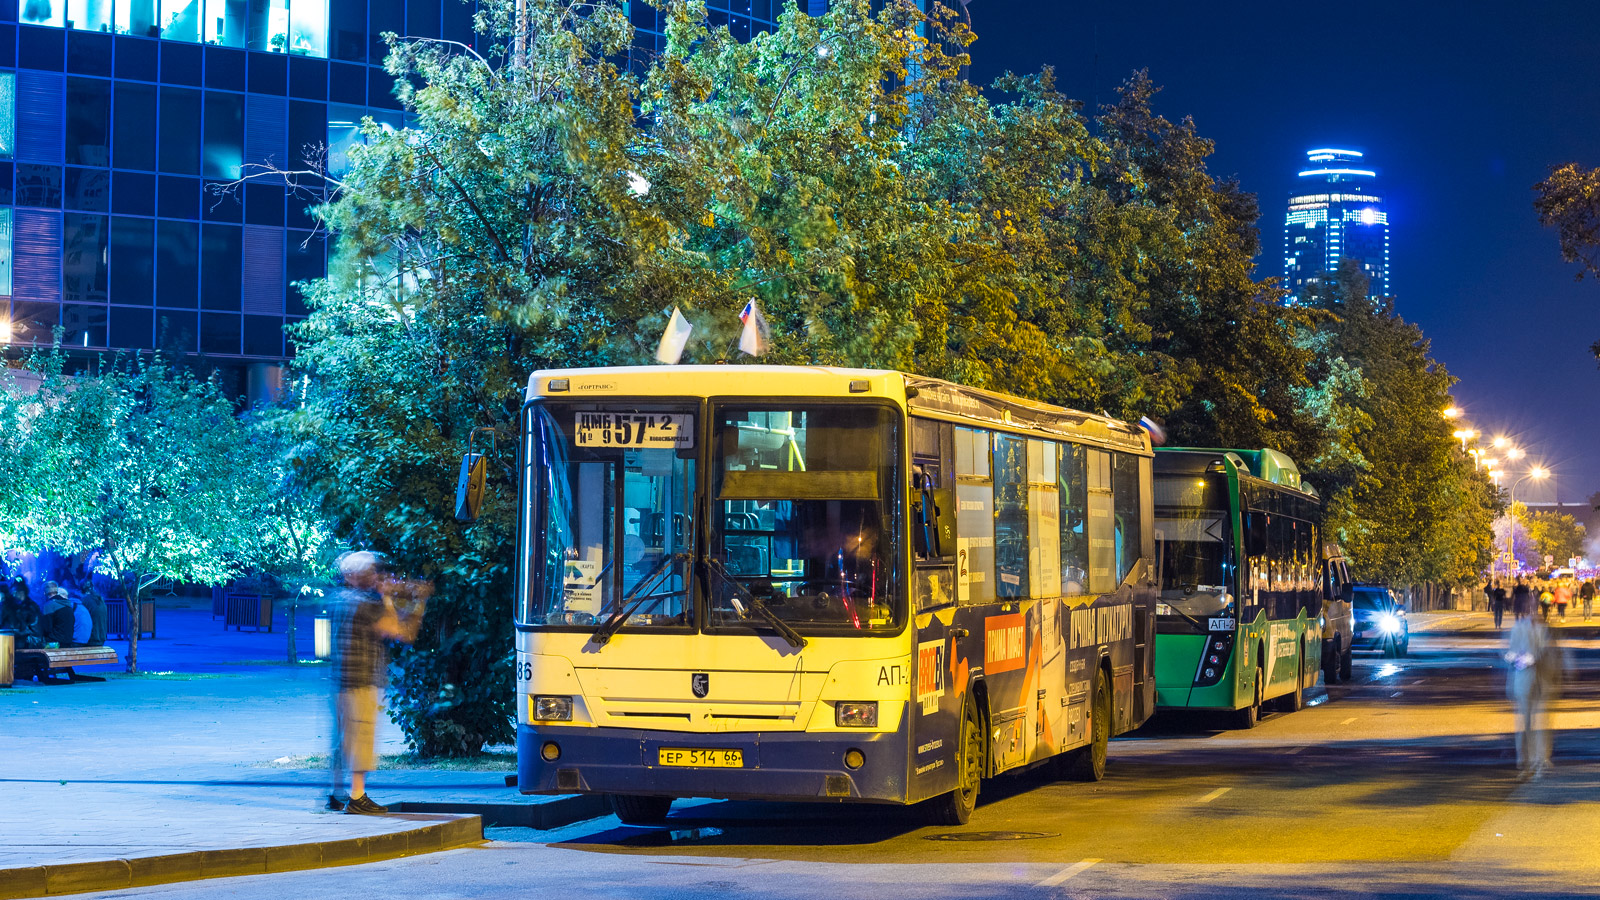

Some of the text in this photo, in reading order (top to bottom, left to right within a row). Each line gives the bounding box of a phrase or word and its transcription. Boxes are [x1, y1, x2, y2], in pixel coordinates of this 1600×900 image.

[603, 430, 611, 444] 9
[1210, 619, 1235, 630] АП-2
[517, 661, 532, 681] 86
[690, 750, 716, 765] 514
[724, 750, 738, 762] 66
